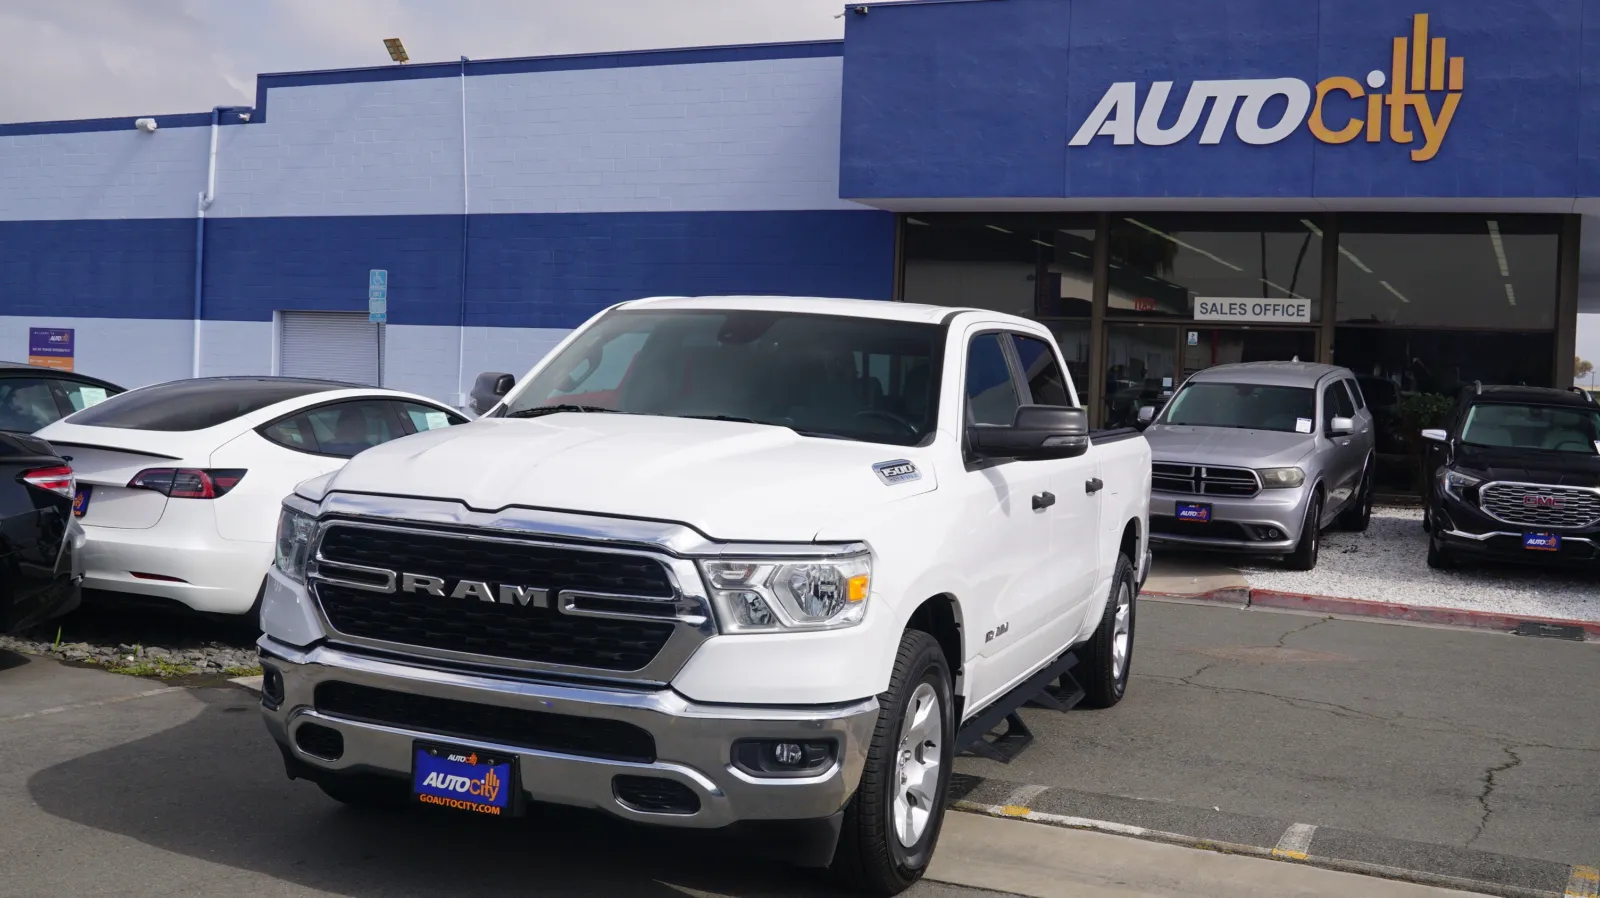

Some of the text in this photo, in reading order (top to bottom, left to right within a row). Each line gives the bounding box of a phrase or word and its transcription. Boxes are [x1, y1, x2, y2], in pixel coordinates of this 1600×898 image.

[1199, 302, 1306, 317] SALES OFFICE
[880, 464, 914, 478] 1500
[1523, 495, 1566, 509] GMC
[402, 572, 550, 609] RAM
[419, 793, 501, 815] GOAUTOCITY.COM
